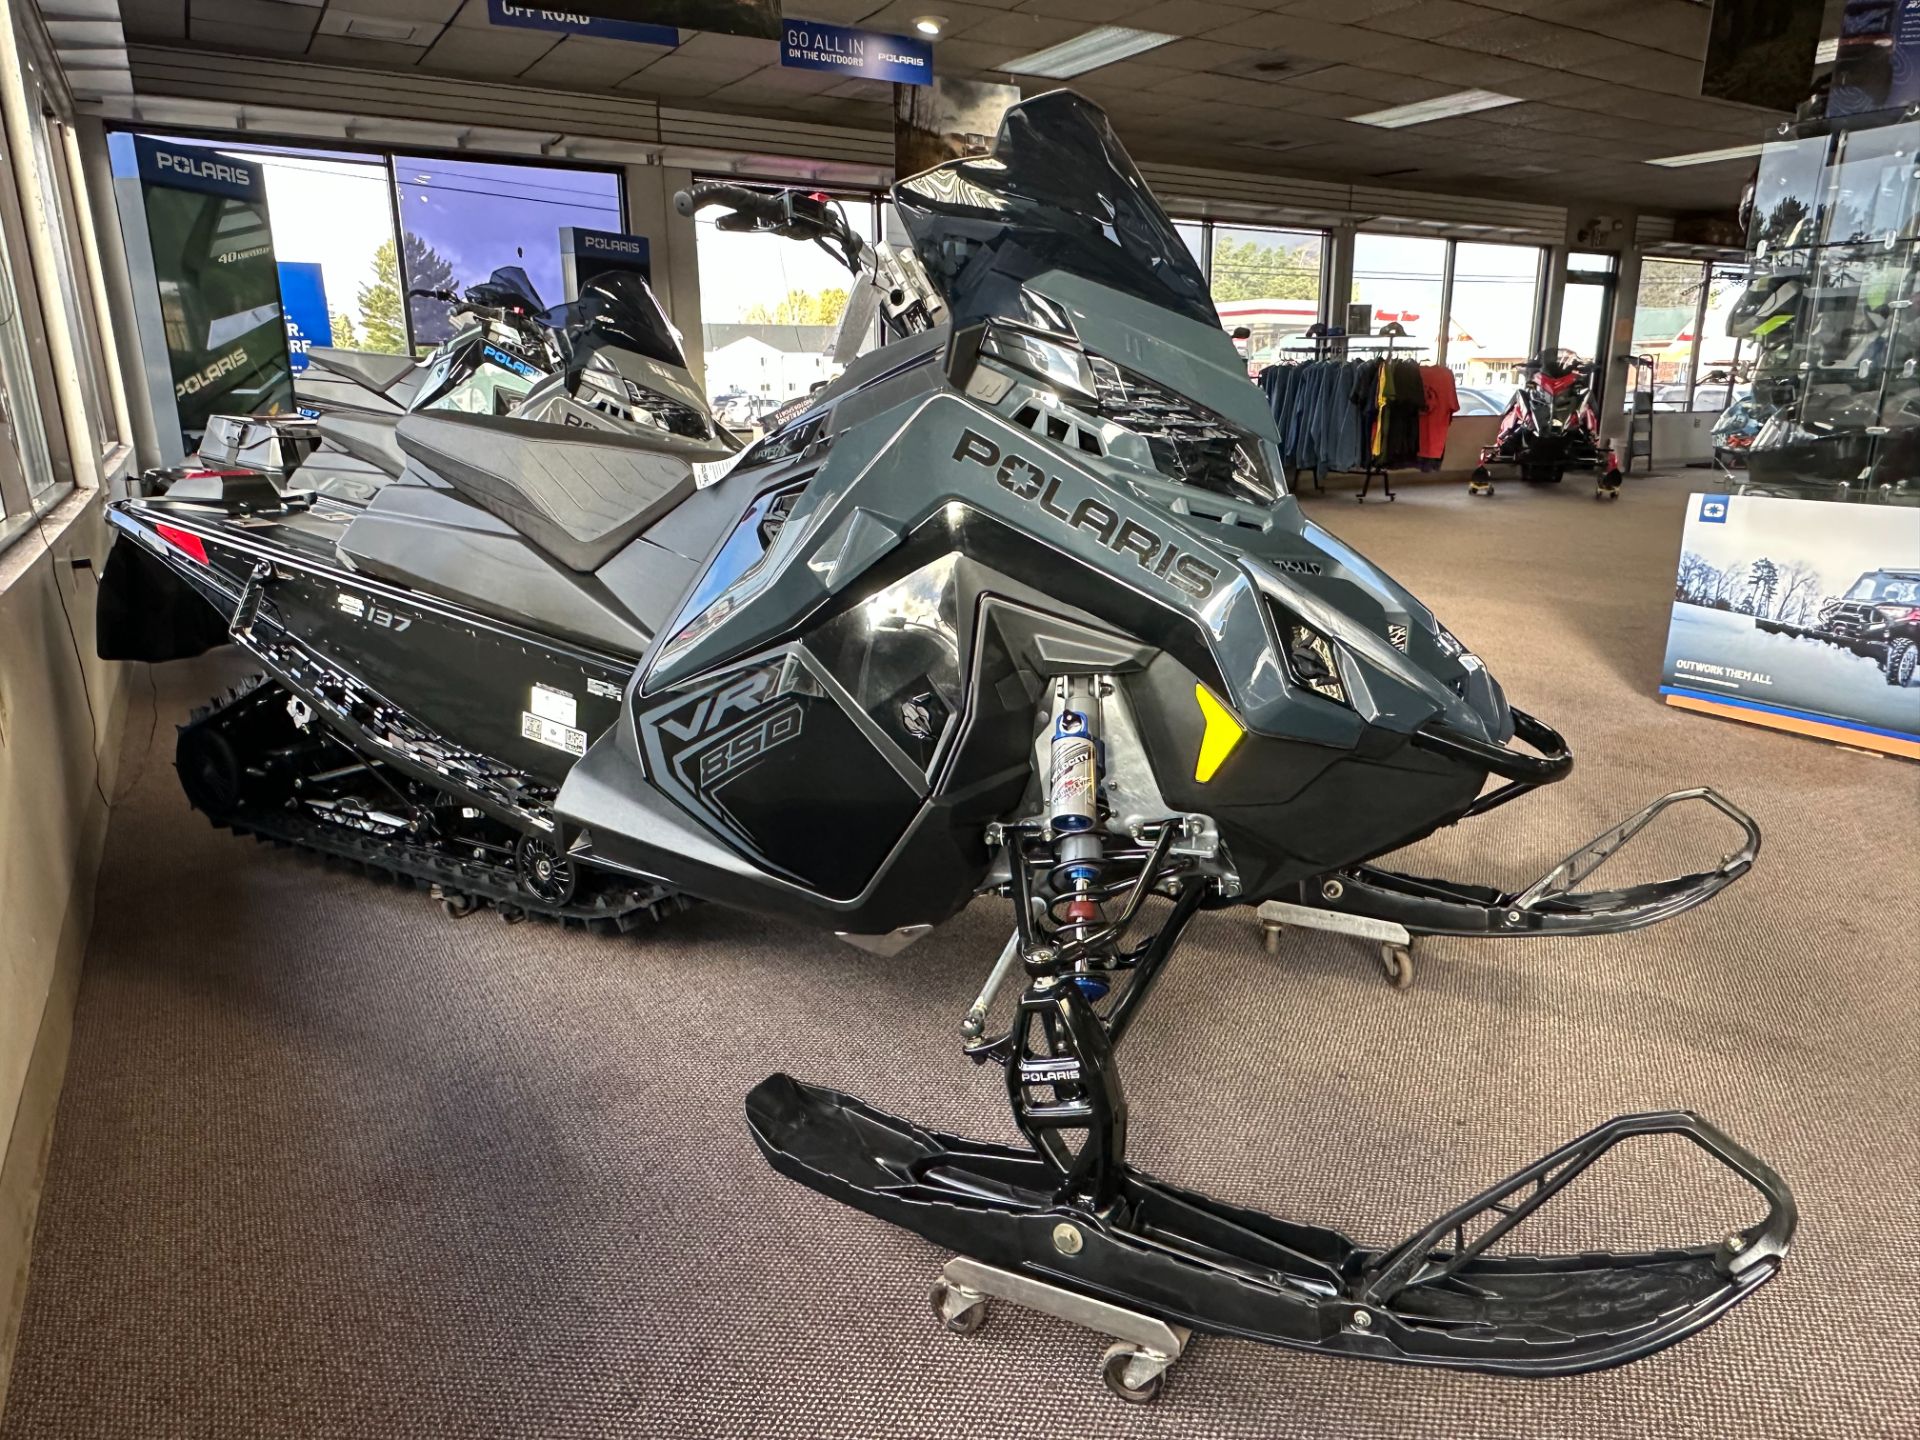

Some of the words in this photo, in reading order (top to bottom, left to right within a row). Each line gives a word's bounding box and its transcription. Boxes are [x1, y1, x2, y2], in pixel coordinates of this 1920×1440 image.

[788, 29, 809, 47] GO
[814, 34, 844, 53] ALL
[849, 38, 864, 55] IN
[788, 49, 801, 58] ON
[803, 51, 819, 61] THE
[820, 53, 864, 67] OUTDOORS
[878, 53, 924, 66] POLARIS
[156, 151, 250, 186] POLARIS
[585, 236, 640, 254] POLARIS
[175, 346, 248, 402] POLARIS
[484, 345, 543, 377] POLAR
[951, 426, 1221, 600] POLARIS
[367, 607, 412, 632] 137
[1675, 659, 1724, 676] OUTWORK
[1725, 667, 1752, 681] THEM
[700, 702, 804, 788] 850
[1051, 752, 1089, 783] LOCITY
[1021, 1070, 1080, 1082] POLARIS
